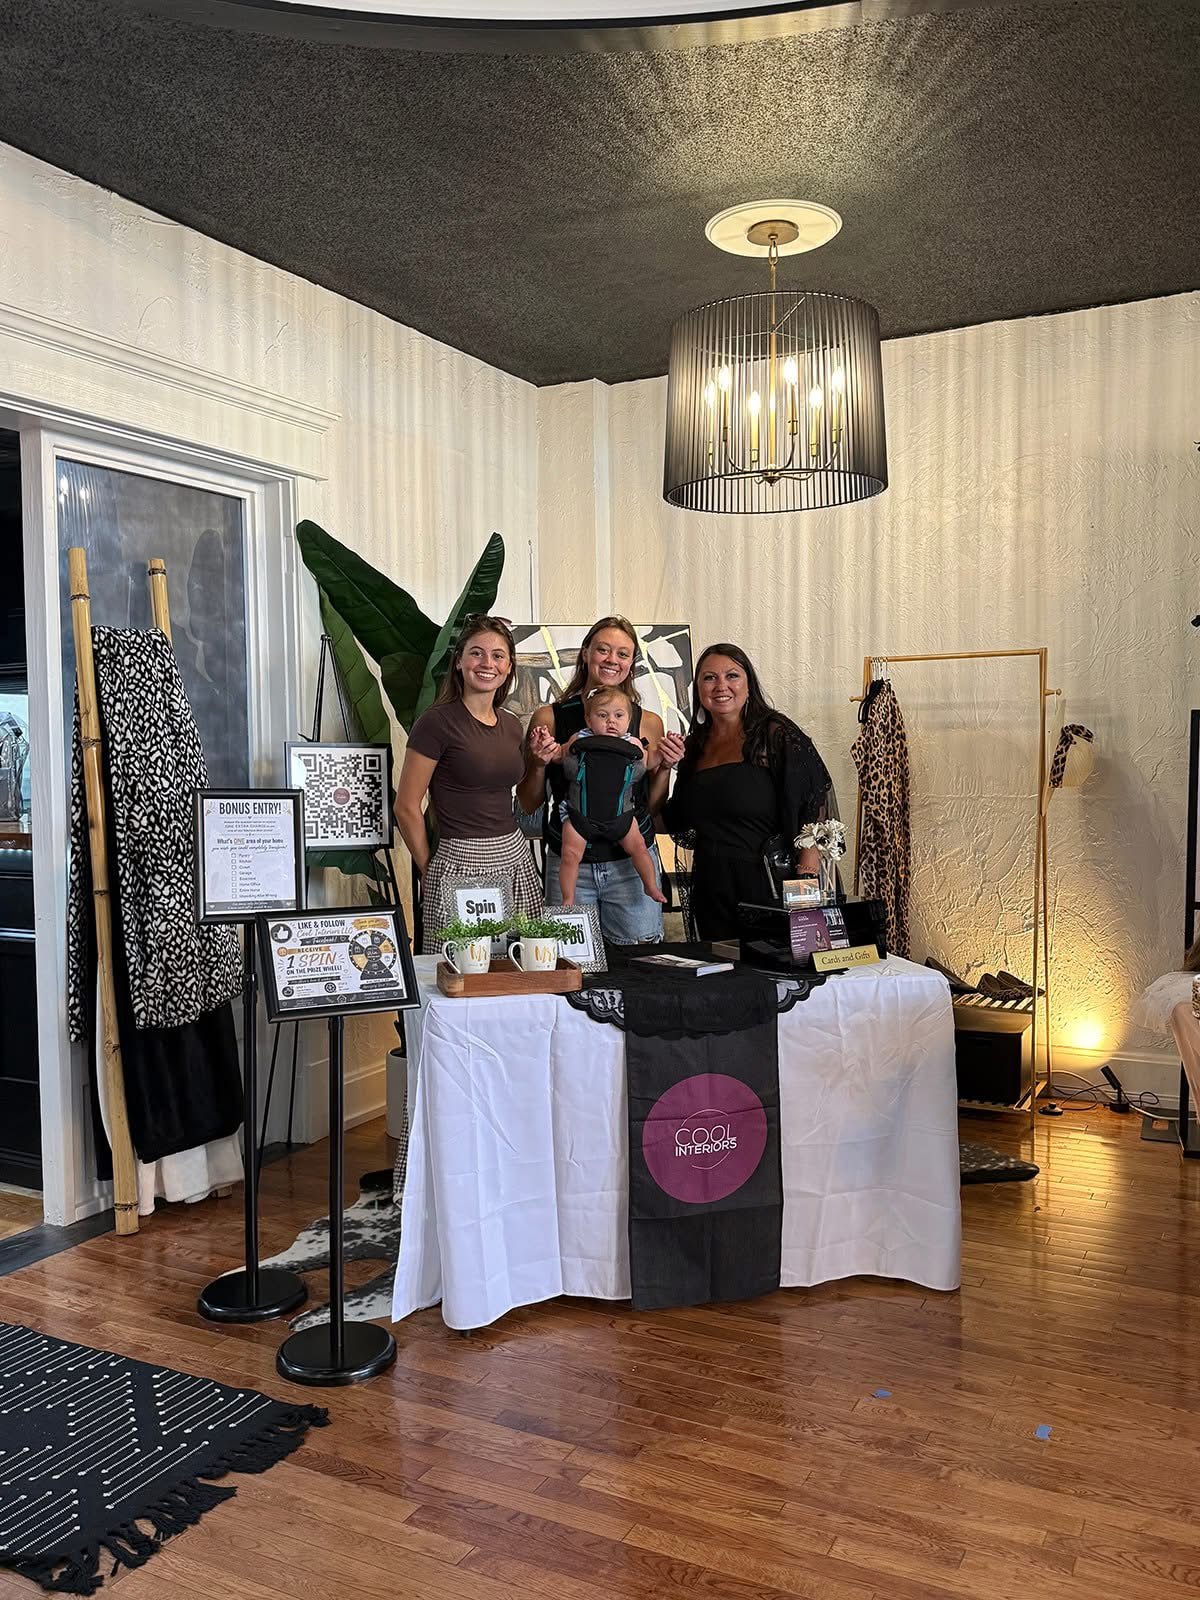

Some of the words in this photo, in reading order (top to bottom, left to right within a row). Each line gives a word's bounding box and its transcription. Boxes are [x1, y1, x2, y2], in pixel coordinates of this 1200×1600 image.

[219, 802, 250, 815] BONUS
[253, 802, 282, 815] ENTRY!
[465, 899, 496, 916] Spin
[296, 928, 312, 938] Cool
[314, 927, 340, 937] Interiors
[297, 920, 312, 930] LIKE
[313, 920, 320, 929] &
[320, 919, 346, 928] FOLLOW
[286, 955, 295, 969] 1
[298, 951, 337, 968] SPIN
[469, 943, 488, 962] Mr
[534, 944, 558, 963] Mrs
[821, 955, 841, 965] Cards
[842, 953, 854, 962] and
[854, 950, 871, 960] Gifts
[286, 968, 295, 976] ON
[295, 967, 307, 975] THE
[307, 966, 322, 974] PRIZE
[675, 1123, 737, 1147] COOL
[675, 1138, 738, 1157] INTERIORS
